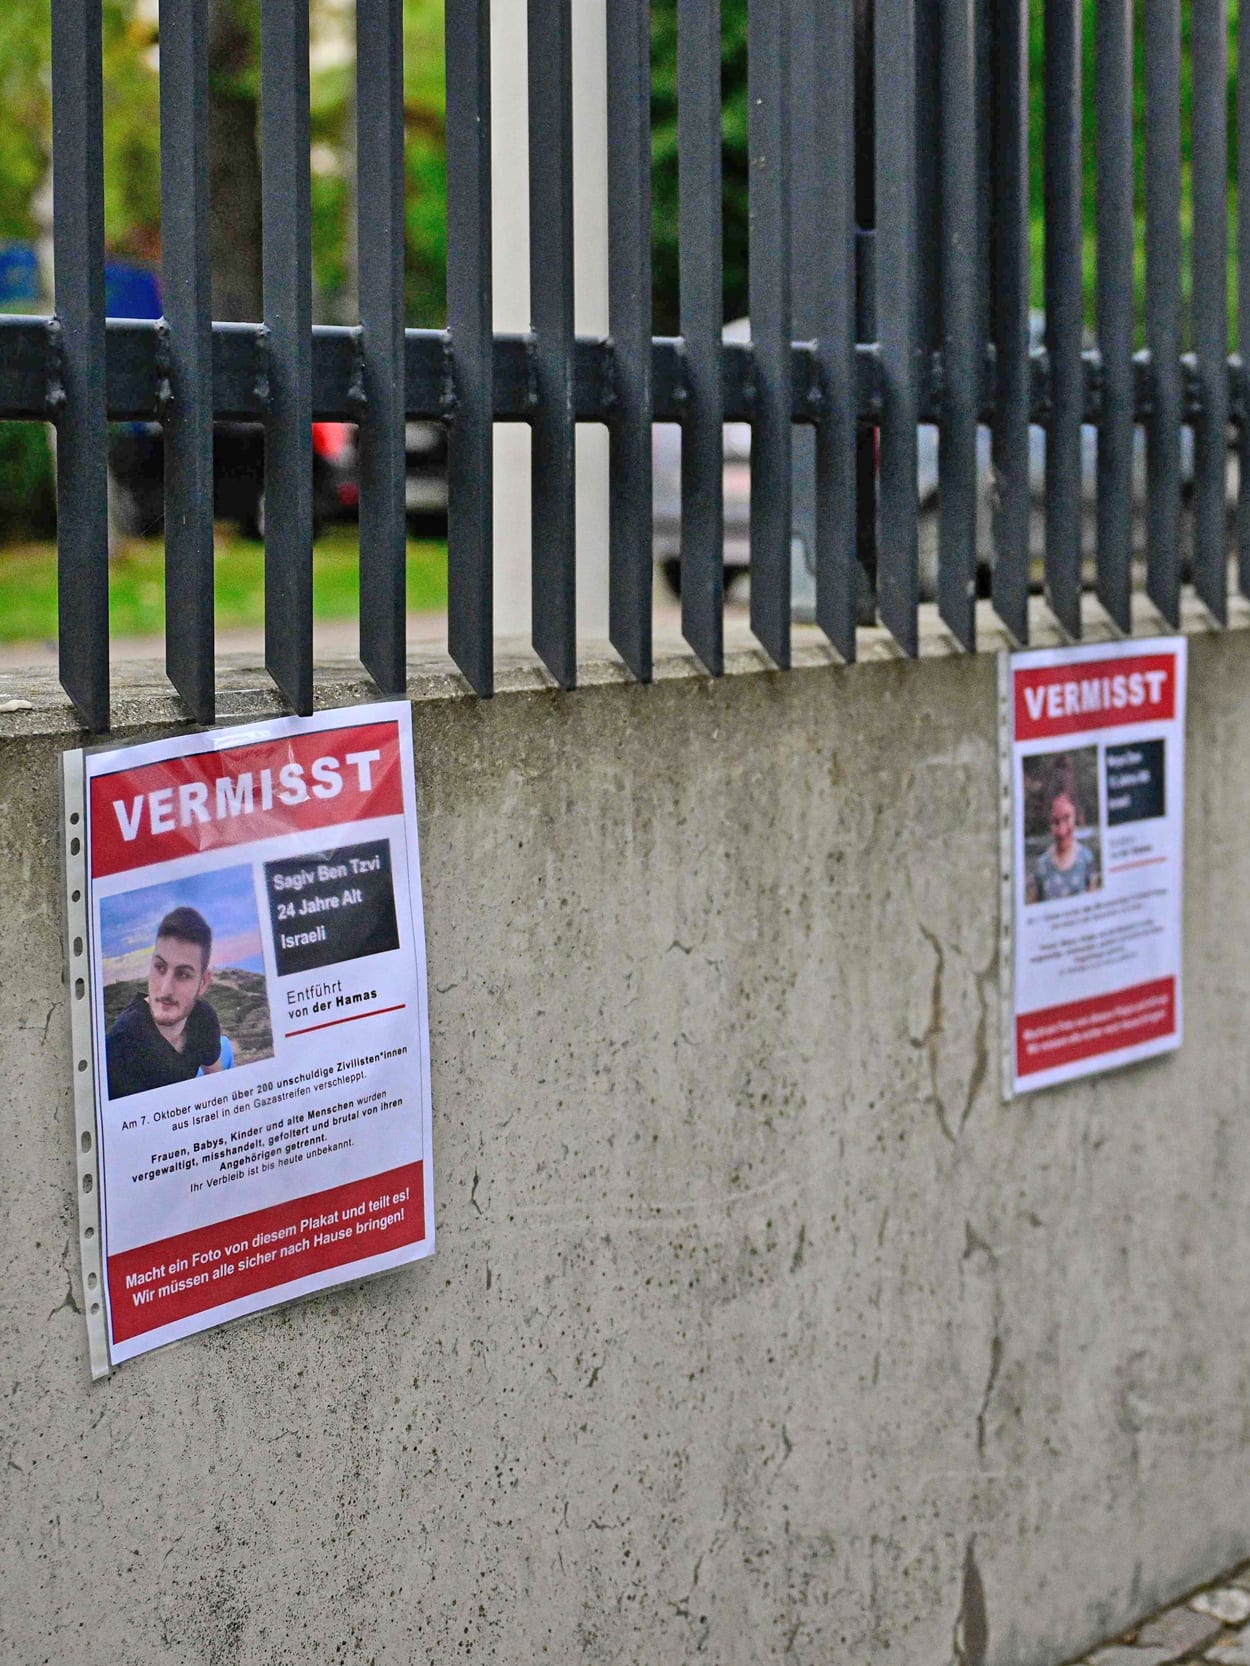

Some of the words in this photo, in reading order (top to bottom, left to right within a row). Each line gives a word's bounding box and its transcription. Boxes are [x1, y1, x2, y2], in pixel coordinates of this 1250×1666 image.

[1024, 670, 1168, 721] VERMISST
[112, 749, 381, 842] VERMISST
[273, 868, 314, 890] Sagiv
[317, 863, 347, 882] Ben
[349, 855, 380, 875] Tzvi
[277, 903, 296, 921] 24
[299, 896, 339, 916] Jahre
[342, 889, 363, 907] Alt
[281, 925, 326, 949] Israeli
[287, 980, 342, 1004] Entführt
[288, 1006, 309, 1019] von
[312, 1000, 332, 1013] der
[336, 989, 378, 1007] Hamas
[121, 1119, 137, 1131] Am
[141, 1115, 150, 1125] 7.
[153, 1105, 191, 1122] Oktober
[194, 1095, 229, 1110] wurden
[231, 1087, 254, 1101] über
[257, 1081, 274, 1094] 200
[277, 1066, 334, 1088] unschuldige
[172, 1120, 189, 1131] aus
[192, 1111, 219, 1126] Israel
[222, 1108, 231, 1118] in
[233, 1103, 251, 1114] den
[254, 1086, 311, 1108] Gazastreifen
[313, 1071, 367, 1092] verschleppt.
[132, 1159, 199, 1183] vergewaltigt,
[268, 1126, 309, 1146] gefoltert
[312, 1120, 330, 1132] und
[332, 1111, 359, 1126] brutal
[362, 1105, 378, 1117] von
[380, 1098, 403, 1111] ihren
[151, 1148, 190, 1164] Frauen,
[193, 1137, 227, 1153] Babys,
[230, 1126, 262, 1142] Kinder
[266, 1120, 284, 1132] und
[287, 1115, 305, 1126] alte
[307, 1100, 354, 1119] Menschen
[356, 1090, 387, 1105] wurden
[219, 1147, 282, 1172] Angehörigen
[285, 1133, 328, 1154] getrennt.
[190, 1181, 203, 1193] Ihr
[206, 1170, 245, 1188] Verbleib
[247, 1167, 259, 1176] ist
[261, 1162, 275, 1172] bis
[278, 1152, 304, 1167] heute
[306, 1138, 354, 1159] unbekannt.
[125, 1264, 166, 1289] Macht
[168, 1258, 188, 1274] ein
[191, 1249, 222, 1267] Foto
[224, 1240, 249, 1256] von
[251, 1224, 297, 1248] diesem
[300, 1211, 339, 1233] Plakat
[342, 1201, 366, 1219] und
[368, 1194, 390, 1212] teilt
[392, 1187, 410, 1204] es!
[132, 1289, 155, 1307] Wir
[158, 1272, 209, 1299] müssen
[212, 1263, 235, 1280] alle
[238, 1250, 277, 1271] sicher
[280, 1239, 310, 1259] nach
[313, 1226, 353, 1248] Hause
[356, 1207, 405, 1234] bringen!
